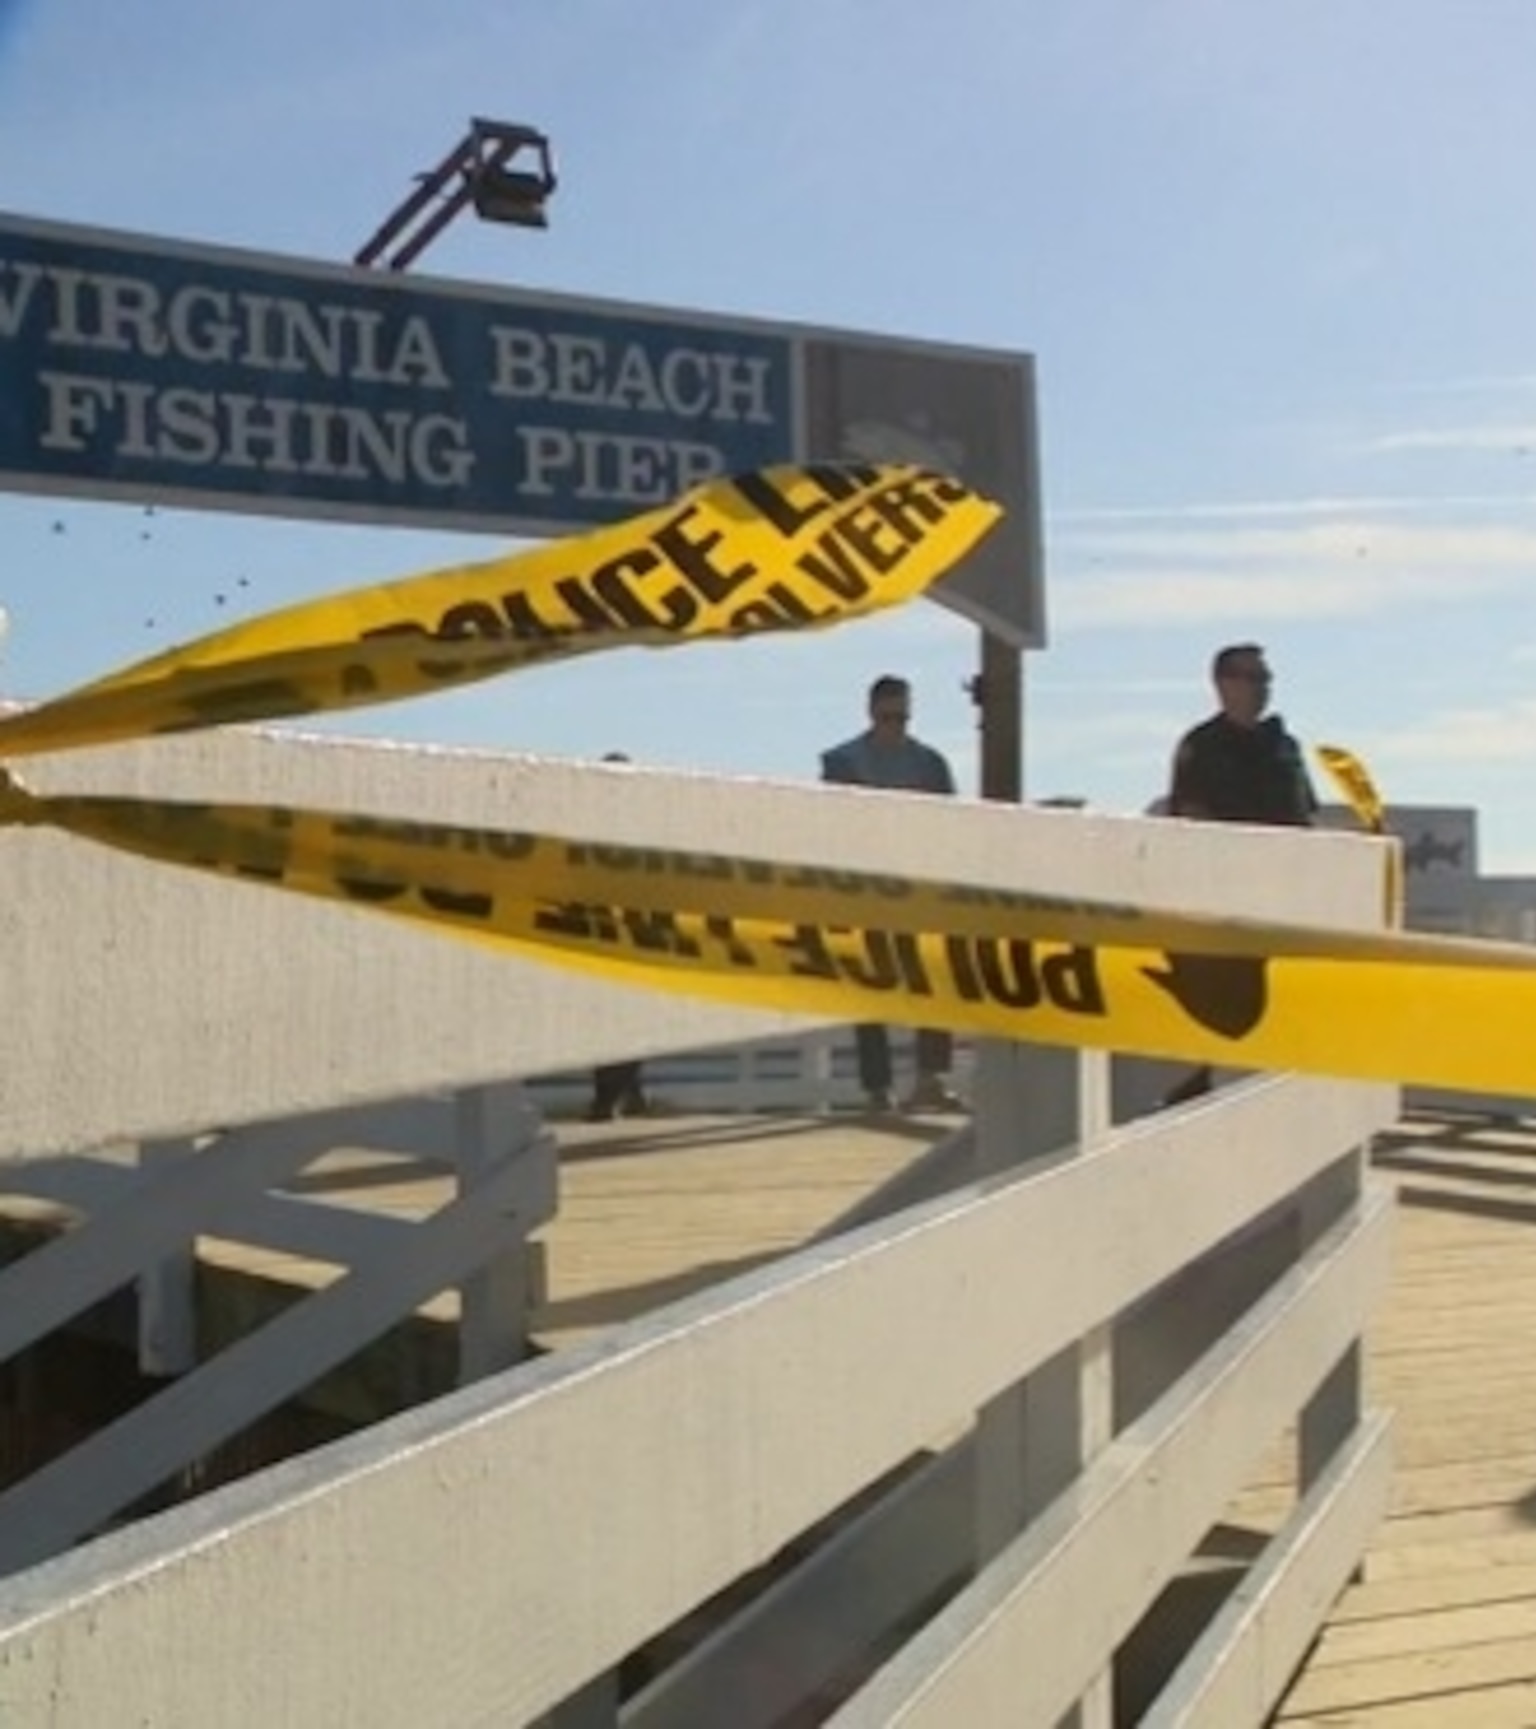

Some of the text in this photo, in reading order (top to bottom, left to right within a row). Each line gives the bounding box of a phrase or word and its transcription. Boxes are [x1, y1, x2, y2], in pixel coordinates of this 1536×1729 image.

[0, 261, 774, 424] VIRGINIA BEACH
[38, 371, 727, 503] FISHING PIER
[360, 505, 758, 640] OLICE
